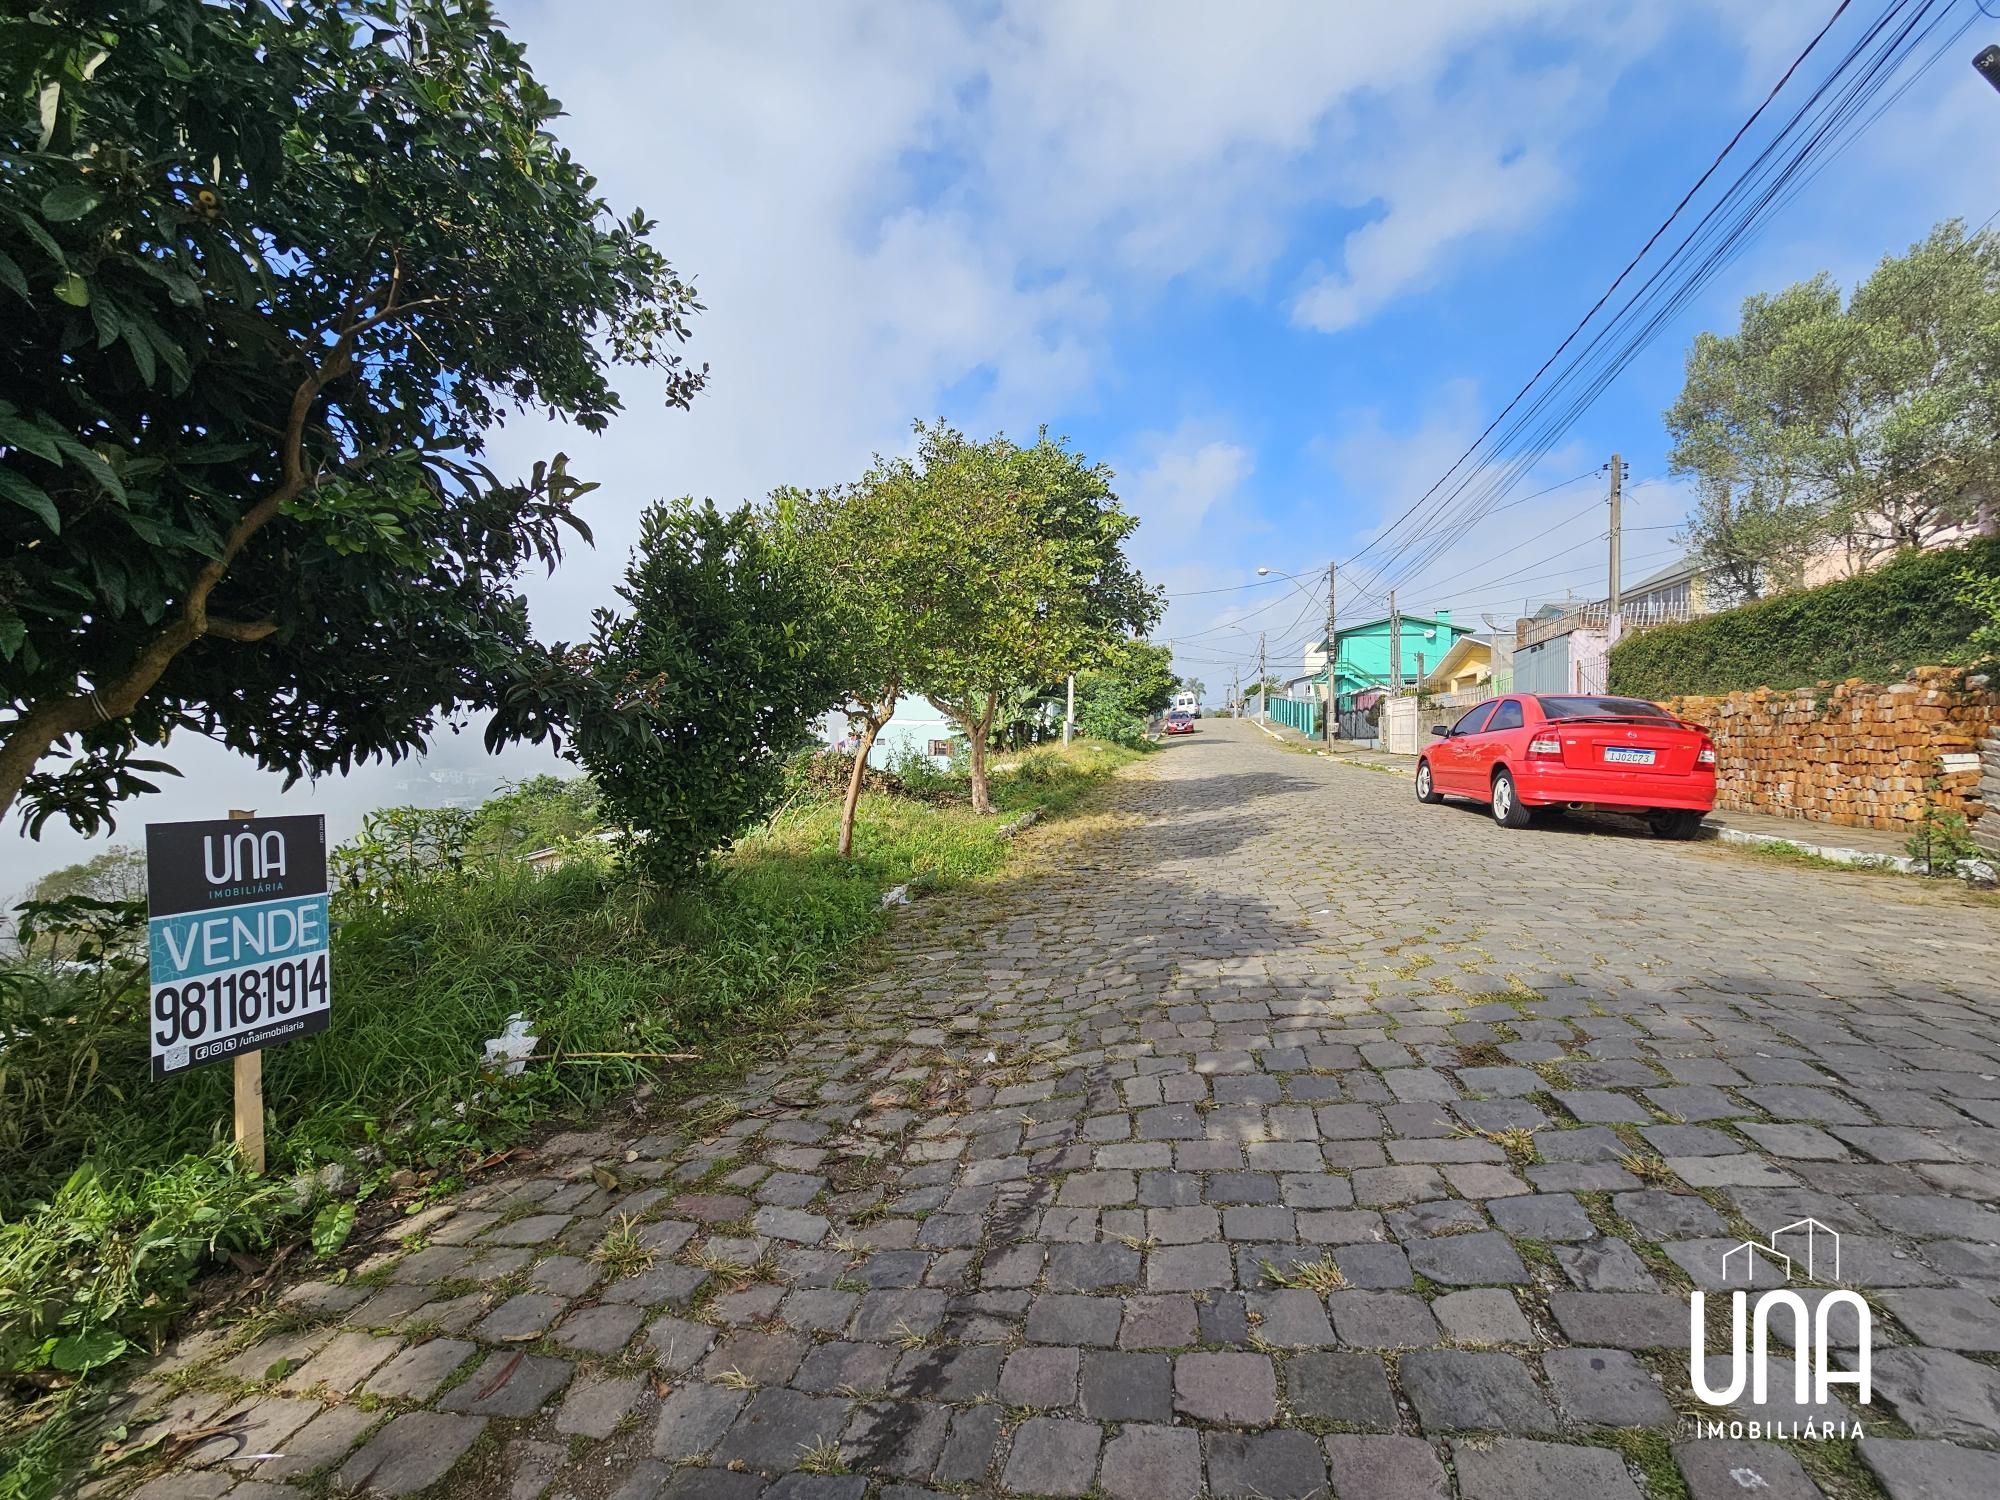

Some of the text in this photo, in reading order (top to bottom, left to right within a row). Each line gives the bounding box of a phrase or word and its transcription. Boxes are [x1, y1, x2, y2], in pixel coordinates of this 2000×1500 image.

[203, 830, 286, 885] UNA
[208, 882, 284, 900] IMOBILIÁRIA
[162, 903, 319, 971] VENDE
